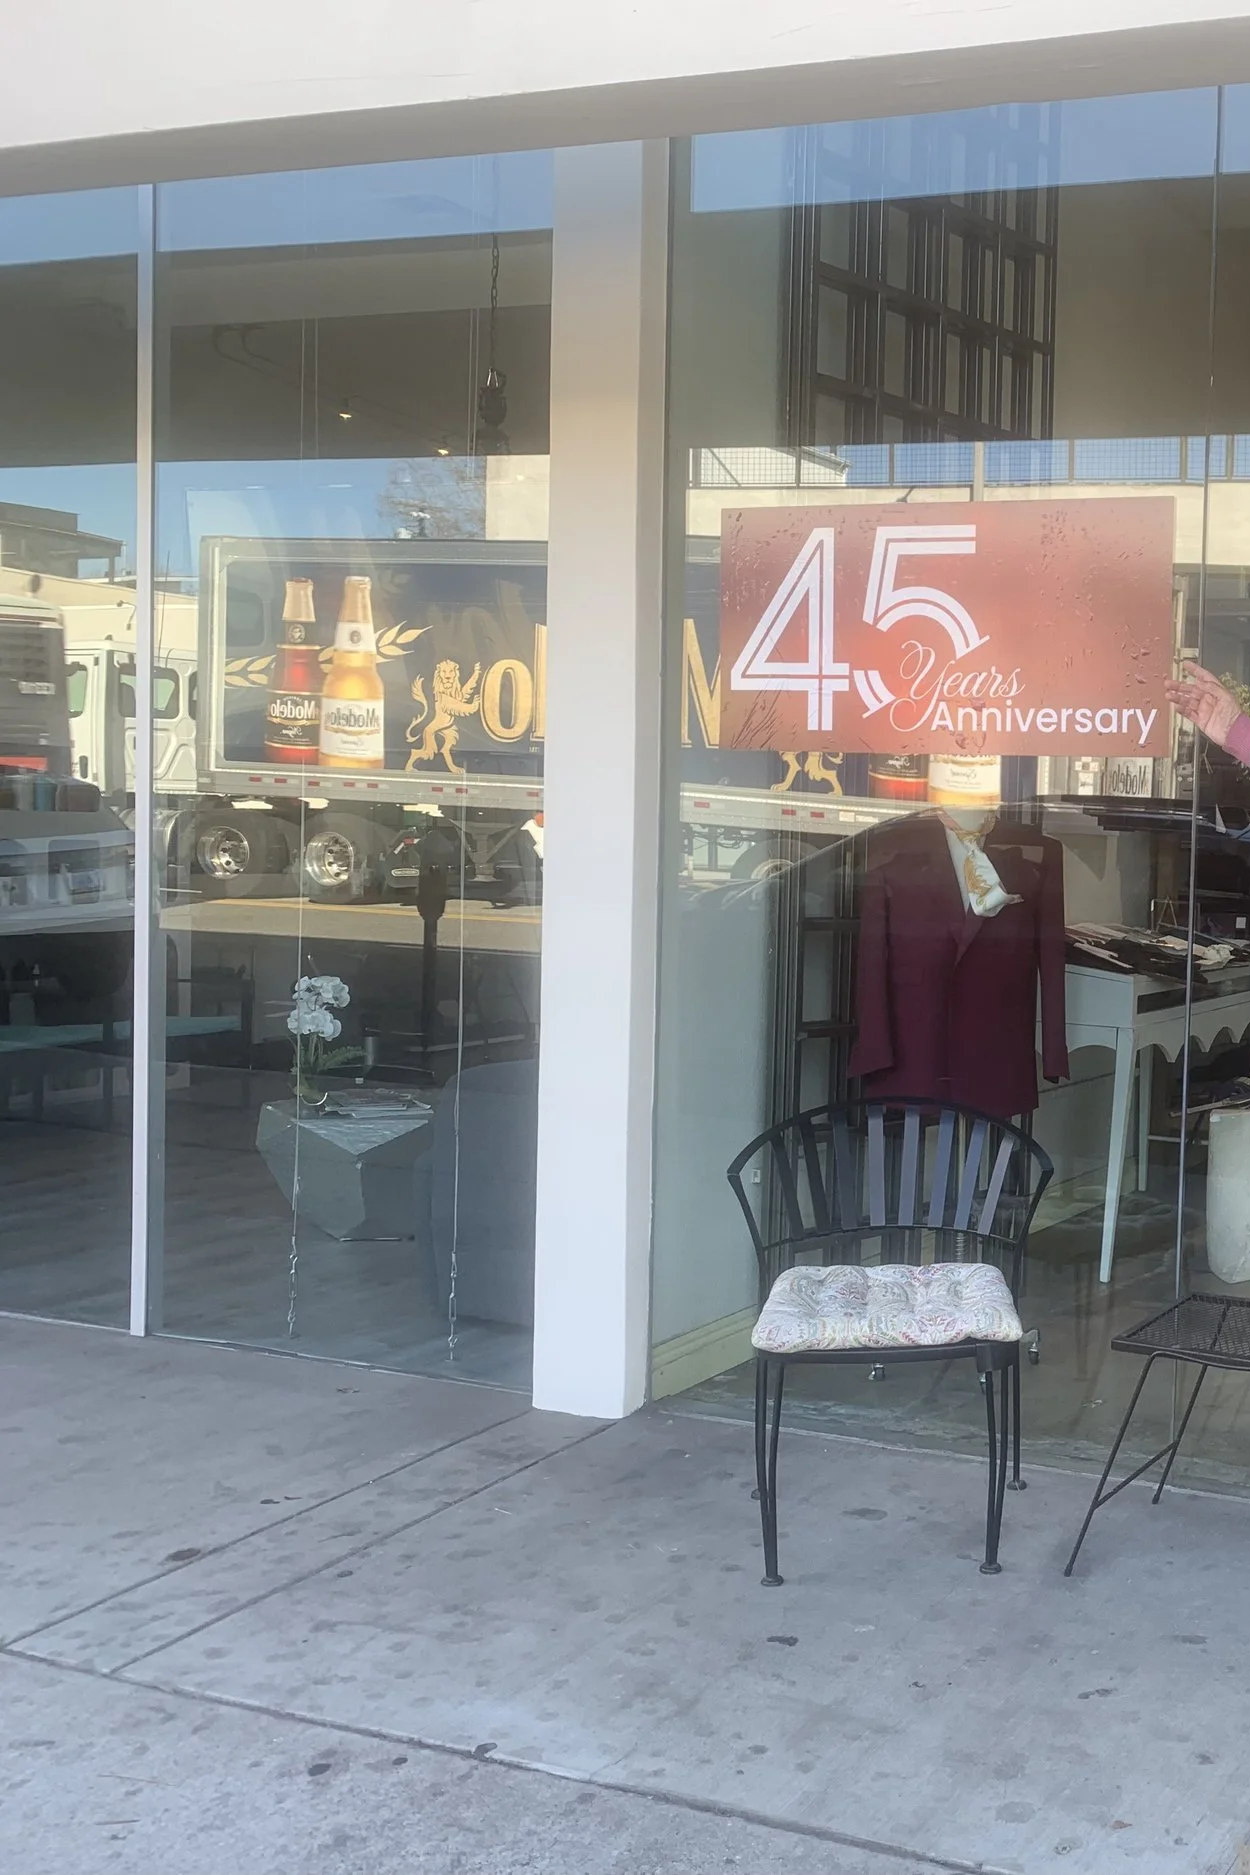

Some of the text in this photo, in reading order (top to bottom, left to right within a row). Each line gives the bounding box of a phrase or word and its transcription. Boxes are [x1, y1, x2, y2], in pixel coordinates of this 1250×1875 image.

[730, 524, 990, 731] 45
[890, 640, 1026, 732] Years
[931, 700, 1158, 744] Anniversary
